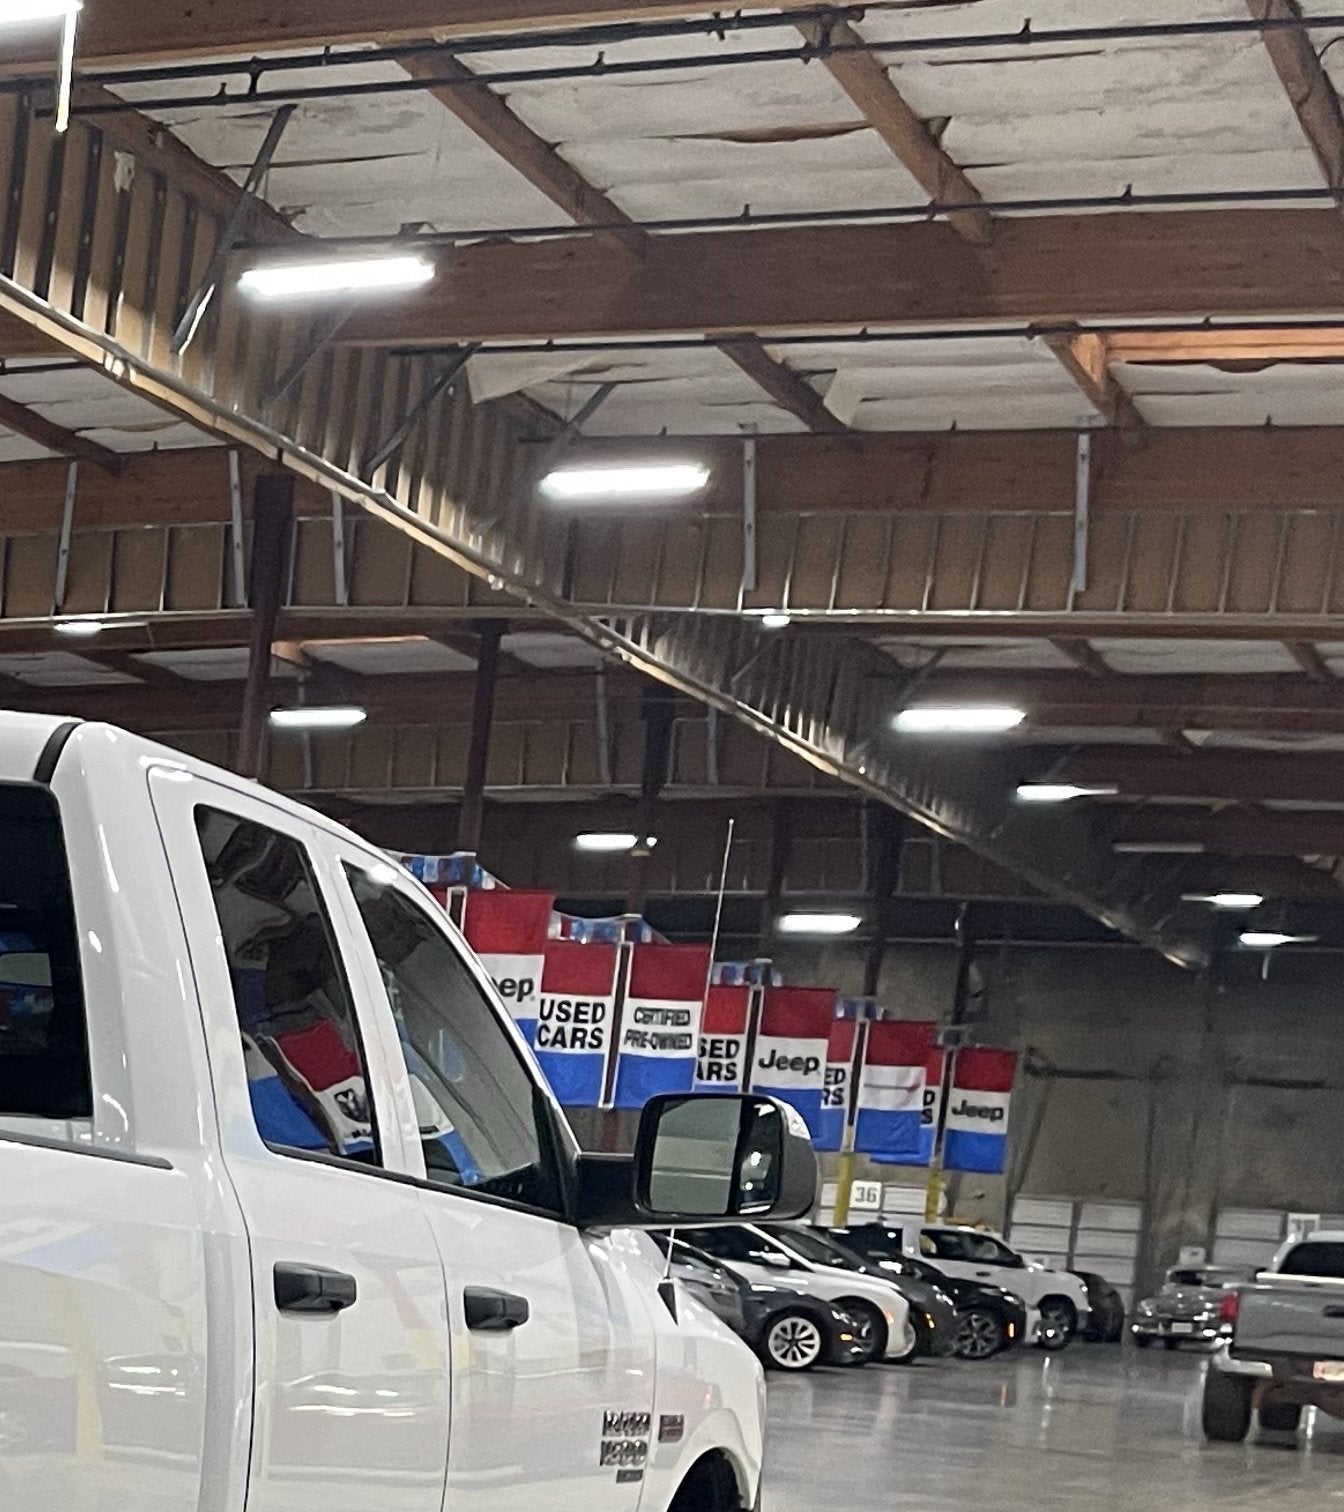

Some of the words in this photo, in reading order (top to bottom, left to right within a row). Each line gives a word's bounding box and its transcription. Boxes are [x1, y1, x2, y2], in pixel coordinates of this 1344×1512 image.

[492, 977, 535, 1002] ep
[539, 999, 606, 1024] USED
[537, 1025, 604, 1049] CARS
[699, 1038, 740, 1058] SED
[697, 1061, 737, 1080] RS
[759, 1049, 820, 1076] Jeep
[952, 1099, 1004, 1122] Jeep
[855, 1187, 878, 1203] 36
